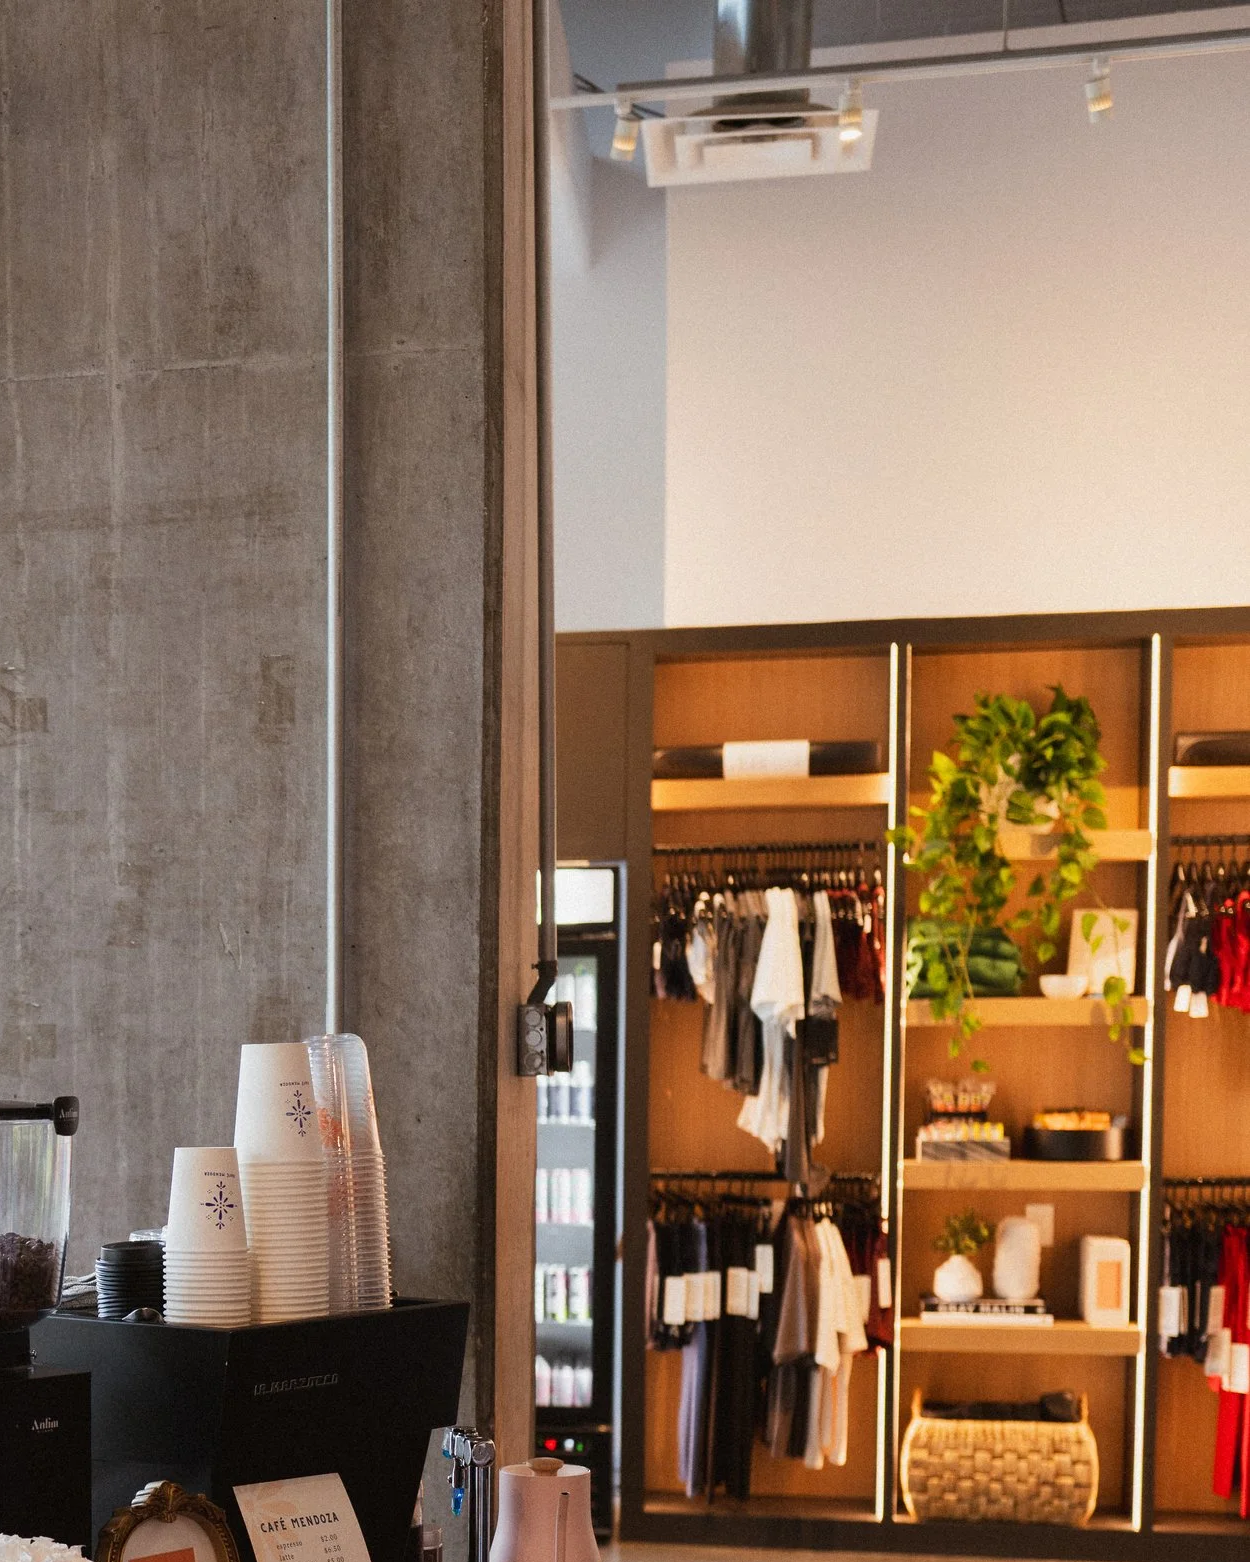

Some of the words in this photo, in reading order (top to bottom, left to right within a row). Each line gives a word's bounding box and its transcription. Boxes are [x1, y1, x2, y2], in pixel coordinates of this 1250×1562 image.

[31, 1416, 60, 1431] Anfim
[260, 1517, 287, 1533] CAFÉ
[291, 1512, 339, 1528] MENDOZA
[276, 1540, 303, 1551] espresso
[320, 1533, 338, 1543] $2.00
[279, 1553, 295, 1562] latte
